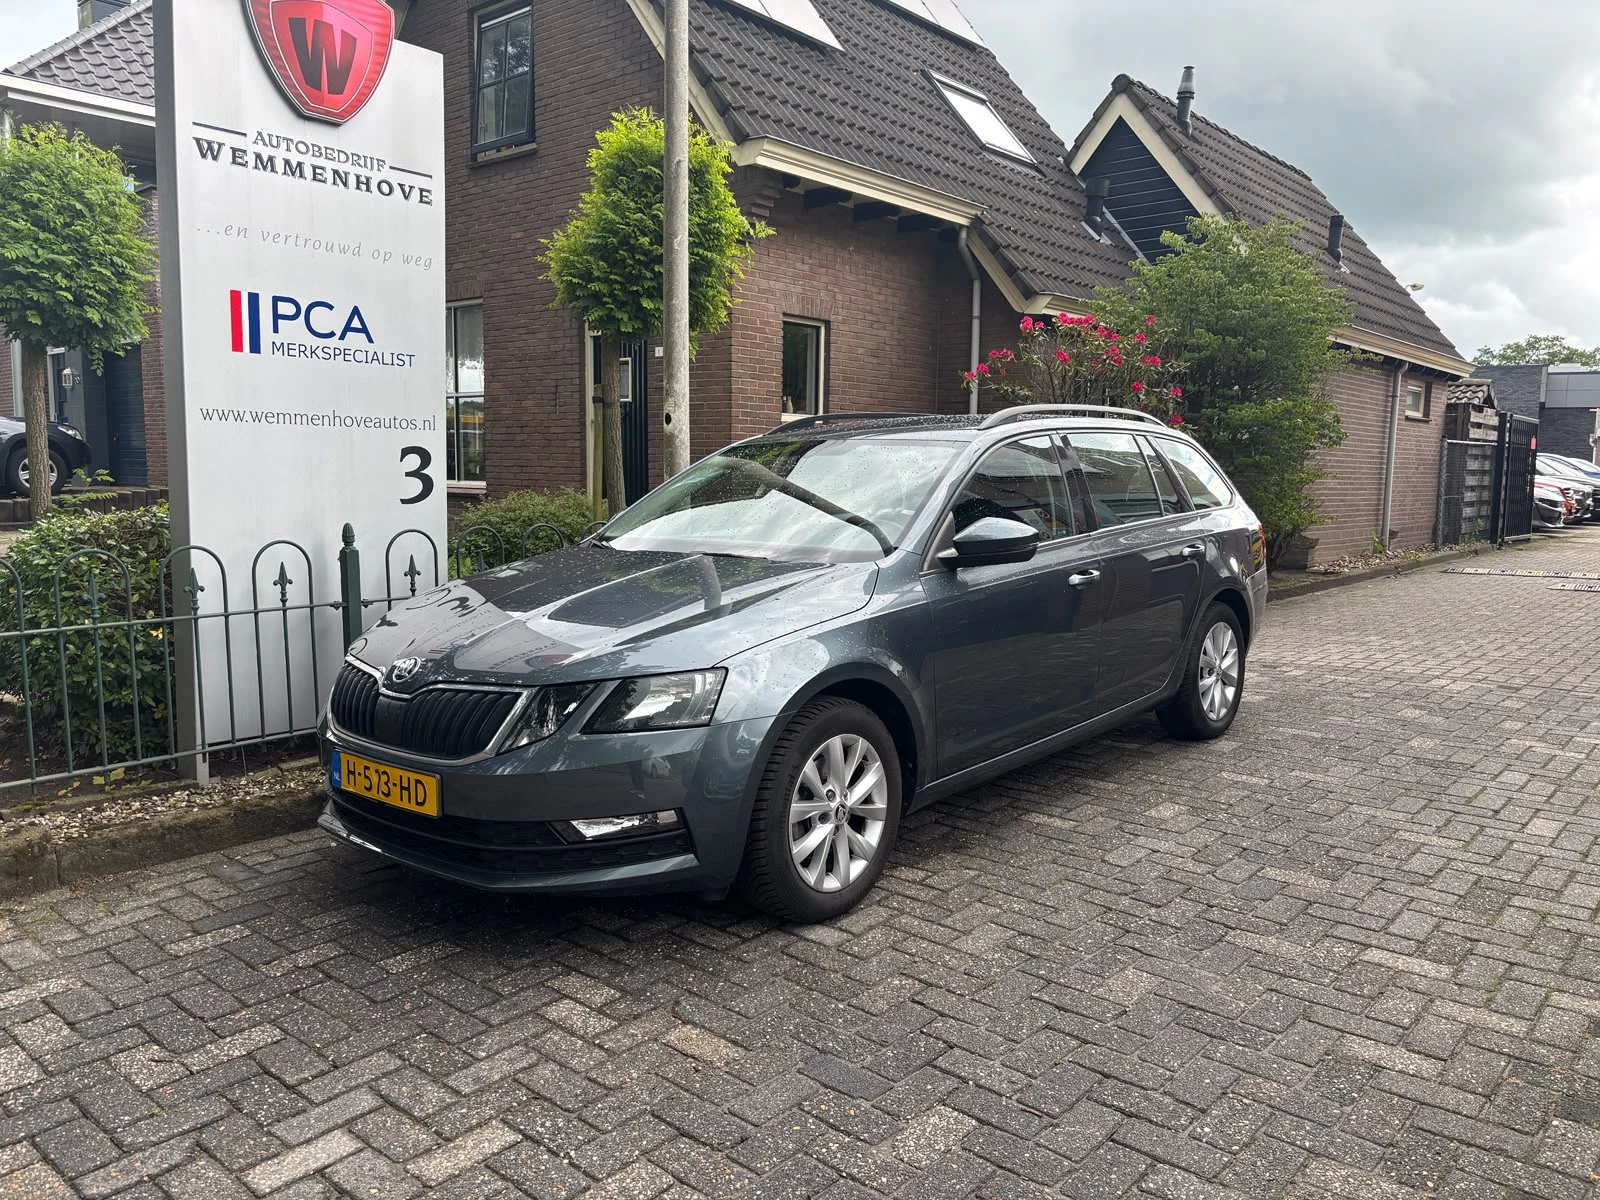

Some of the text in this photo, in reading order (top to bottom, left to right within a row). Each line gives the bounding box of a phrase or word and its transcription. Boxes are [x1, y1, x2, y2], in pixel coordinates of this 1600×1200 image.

[192, 136, 432, 206] WEMMENHOVE
[253, 131, 386, 172] AUTOBEDRIJF
[261, 228, 361, 257] vertrouwd
[372, 248, 393, 263] op
[402, 252, 433, 271] weg
[271, 295, 374, 344] PCA
[271, 341, 415, 367] MERKSPECIALIST
[200, 407, 436, 431] www.wemmenhoveautos.nl
[399, 445, 434, 505] 3
